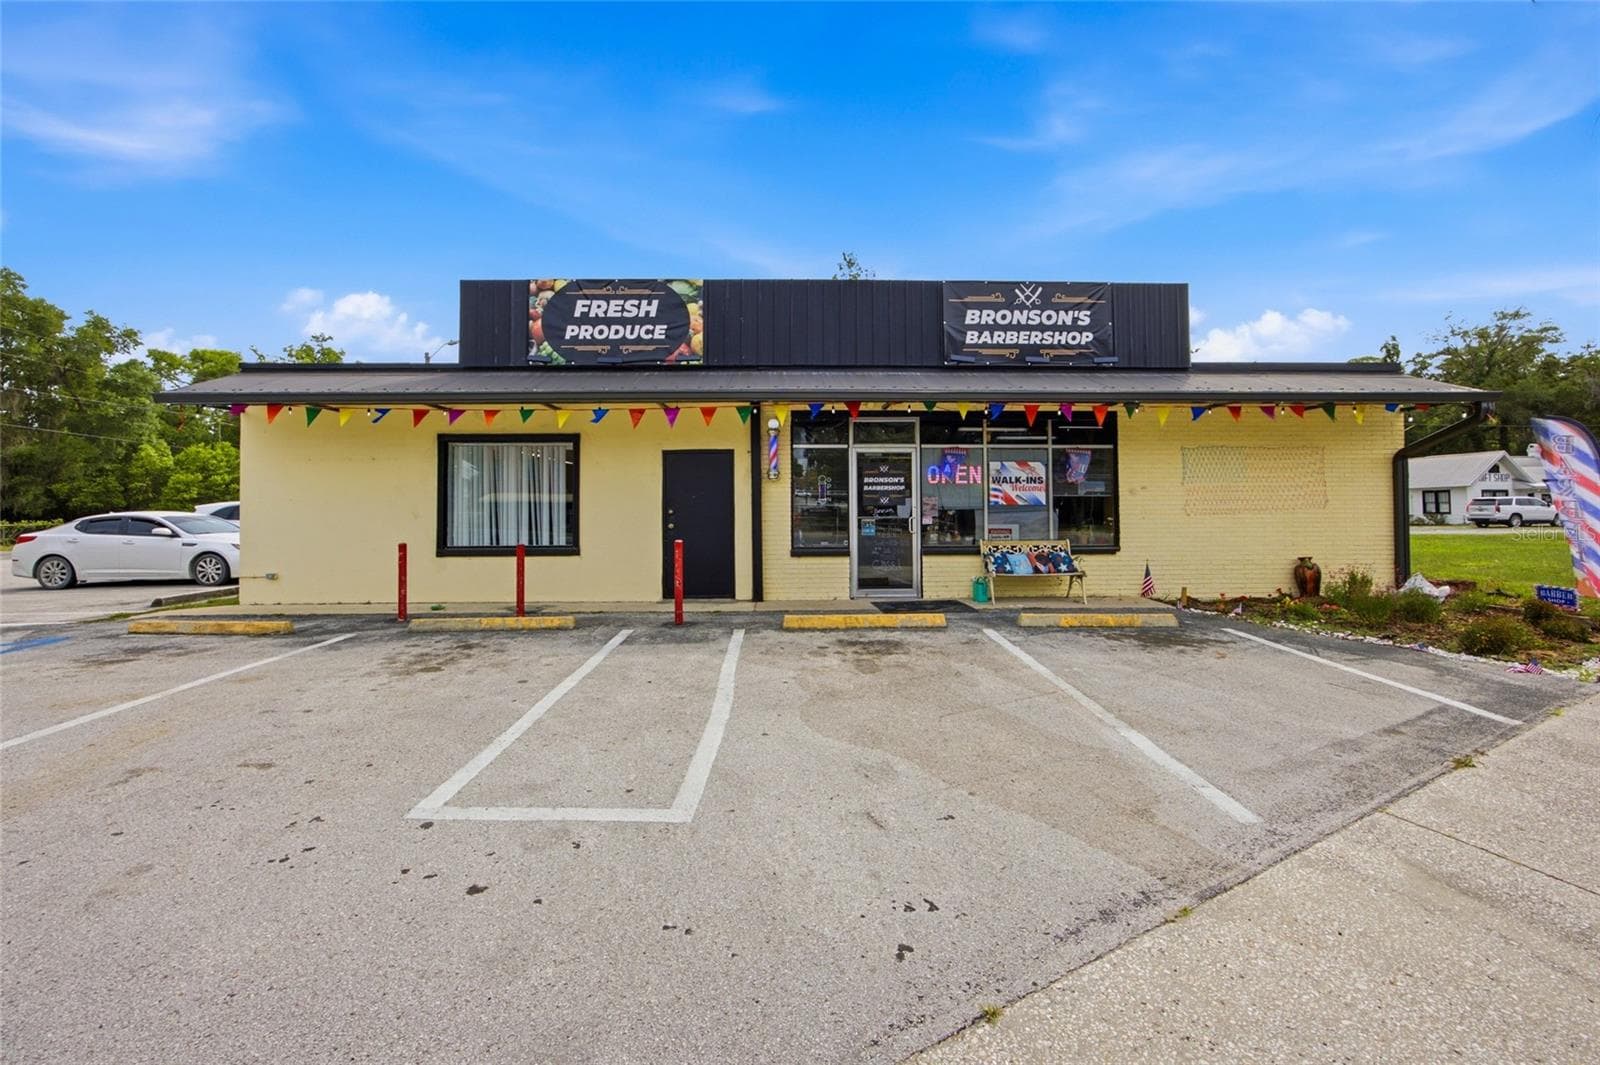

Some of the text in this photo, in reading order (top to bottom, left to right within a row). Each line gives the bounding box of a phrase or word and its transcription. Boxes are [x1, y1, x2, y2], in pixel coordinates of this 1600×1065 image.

[573, 299, 659, 318] FRESH
[964, 309, 1092, 326] BRONSON'S
[564, 325, 667, 340] PRODUCE
[965, 330, 1094, 345] BARBERSHOP
[992, 476, 1044, 485] WALK-INS
[1540, 589, 1574, 600] BARBER
